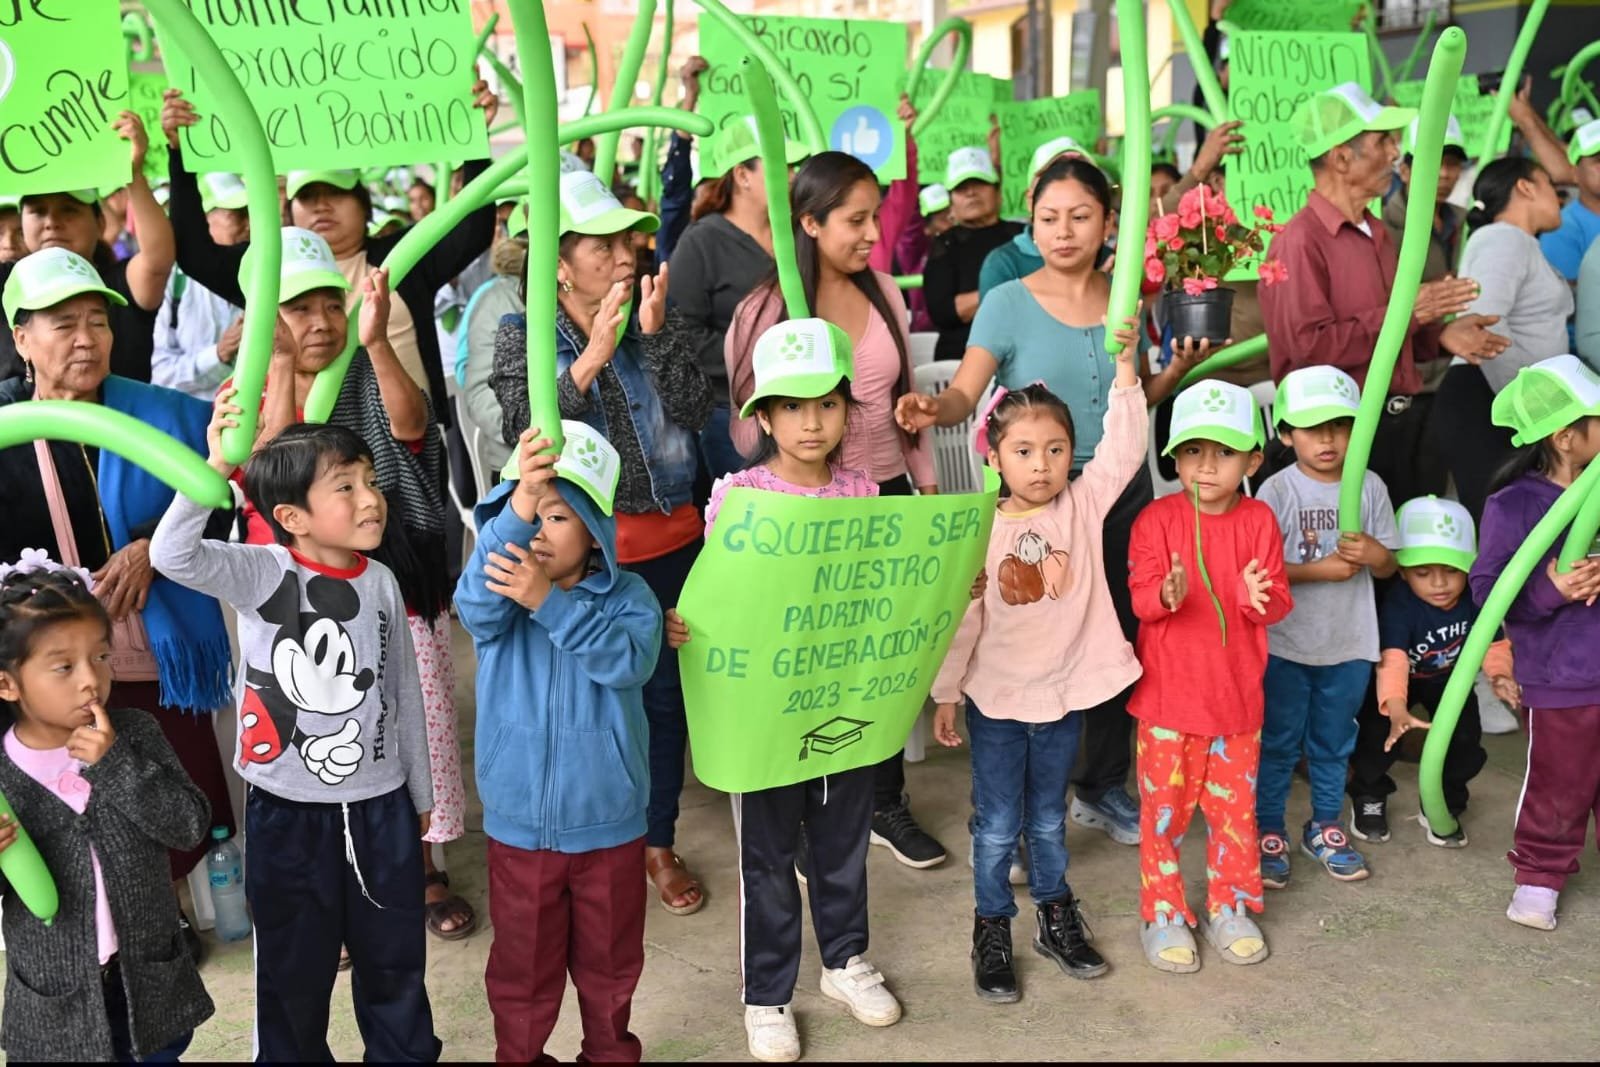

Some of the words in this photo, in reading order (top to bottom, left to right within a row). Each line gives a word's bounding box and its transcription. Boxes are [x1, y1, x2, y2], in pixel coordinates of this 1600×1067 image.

[744, 17, 873, 58] Ricardo
[189, 28, 458, 93] gradecido
[267, 103, 308, 149] el
[316, 90, 474, 149] Padrino
[722, 501, 904, 557] ¿QUIERES
[928, 506, 981, 547] SER
[1299, 508, 1340, 531] HERS
[813, 553, 941, 594] NUESTRO
[782, 597, 893, 633] PADRINO
[1436, 621, 1469, 642] THE
[706, 647, 750, 678] DE
[772, 610, 952, 679] GENERACIÓN?
